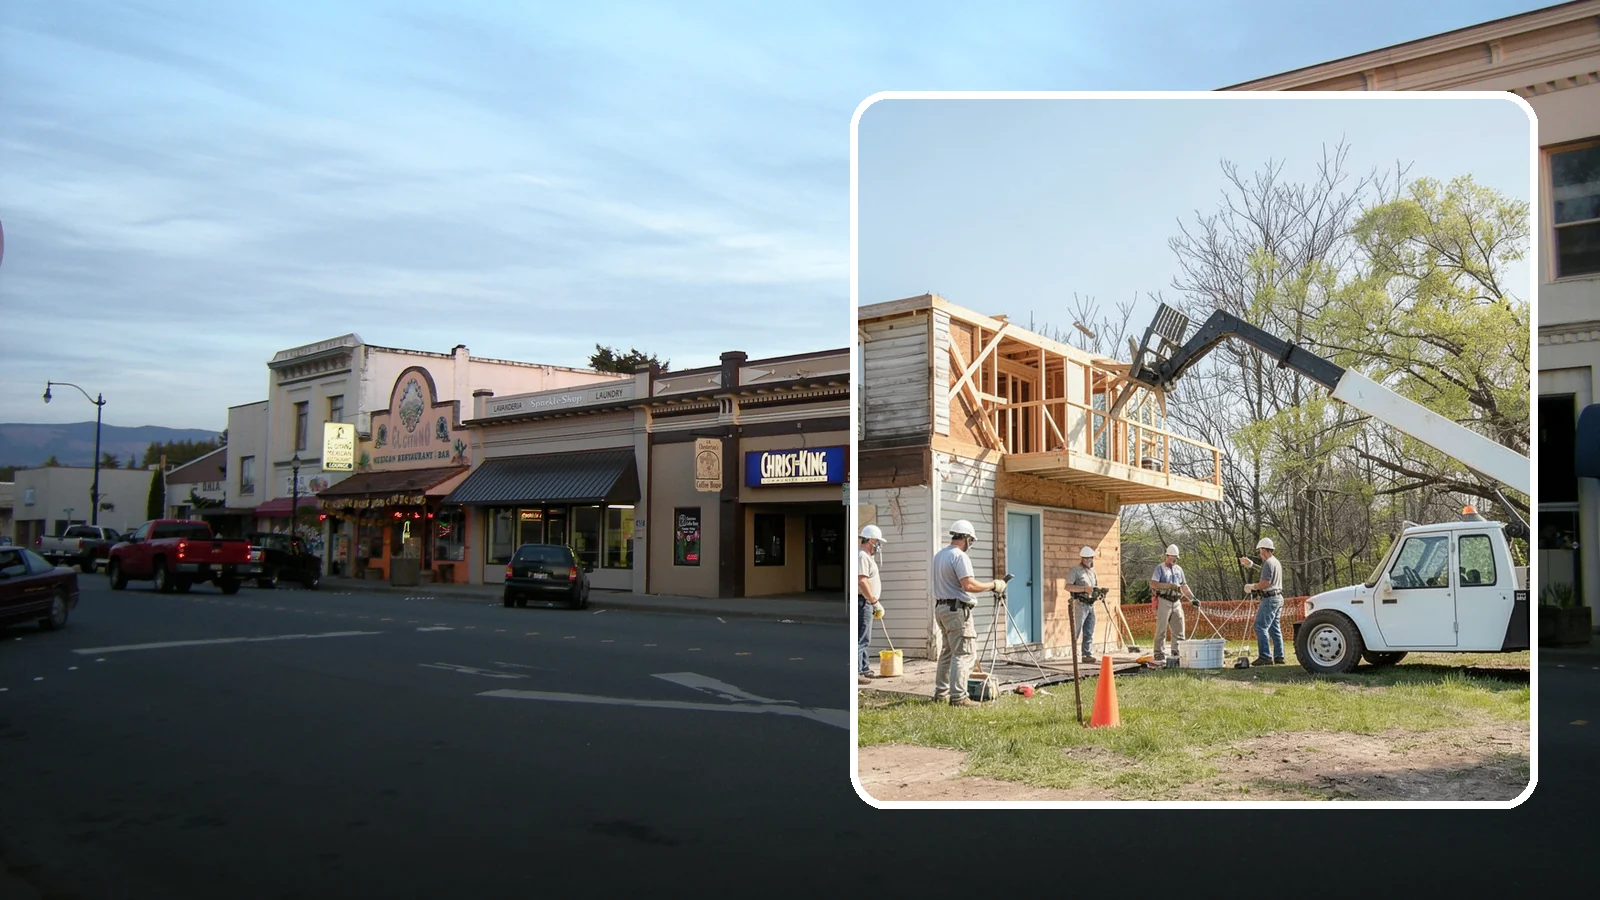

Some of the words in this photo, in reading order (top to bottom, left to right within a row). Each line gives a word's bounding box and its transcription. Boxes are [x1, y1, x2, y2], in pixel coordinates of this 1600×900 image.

[595, 389, 624, 400] LAUNDRY
[493, 402, 522, 412] LAVANDERIA
[373, 454, 396, 465] MEXICAN
[397, 451, 434, 463] RESTAURANT
[438, 450, 450, 459] BAR
[799, 450, 827, 476] KING
